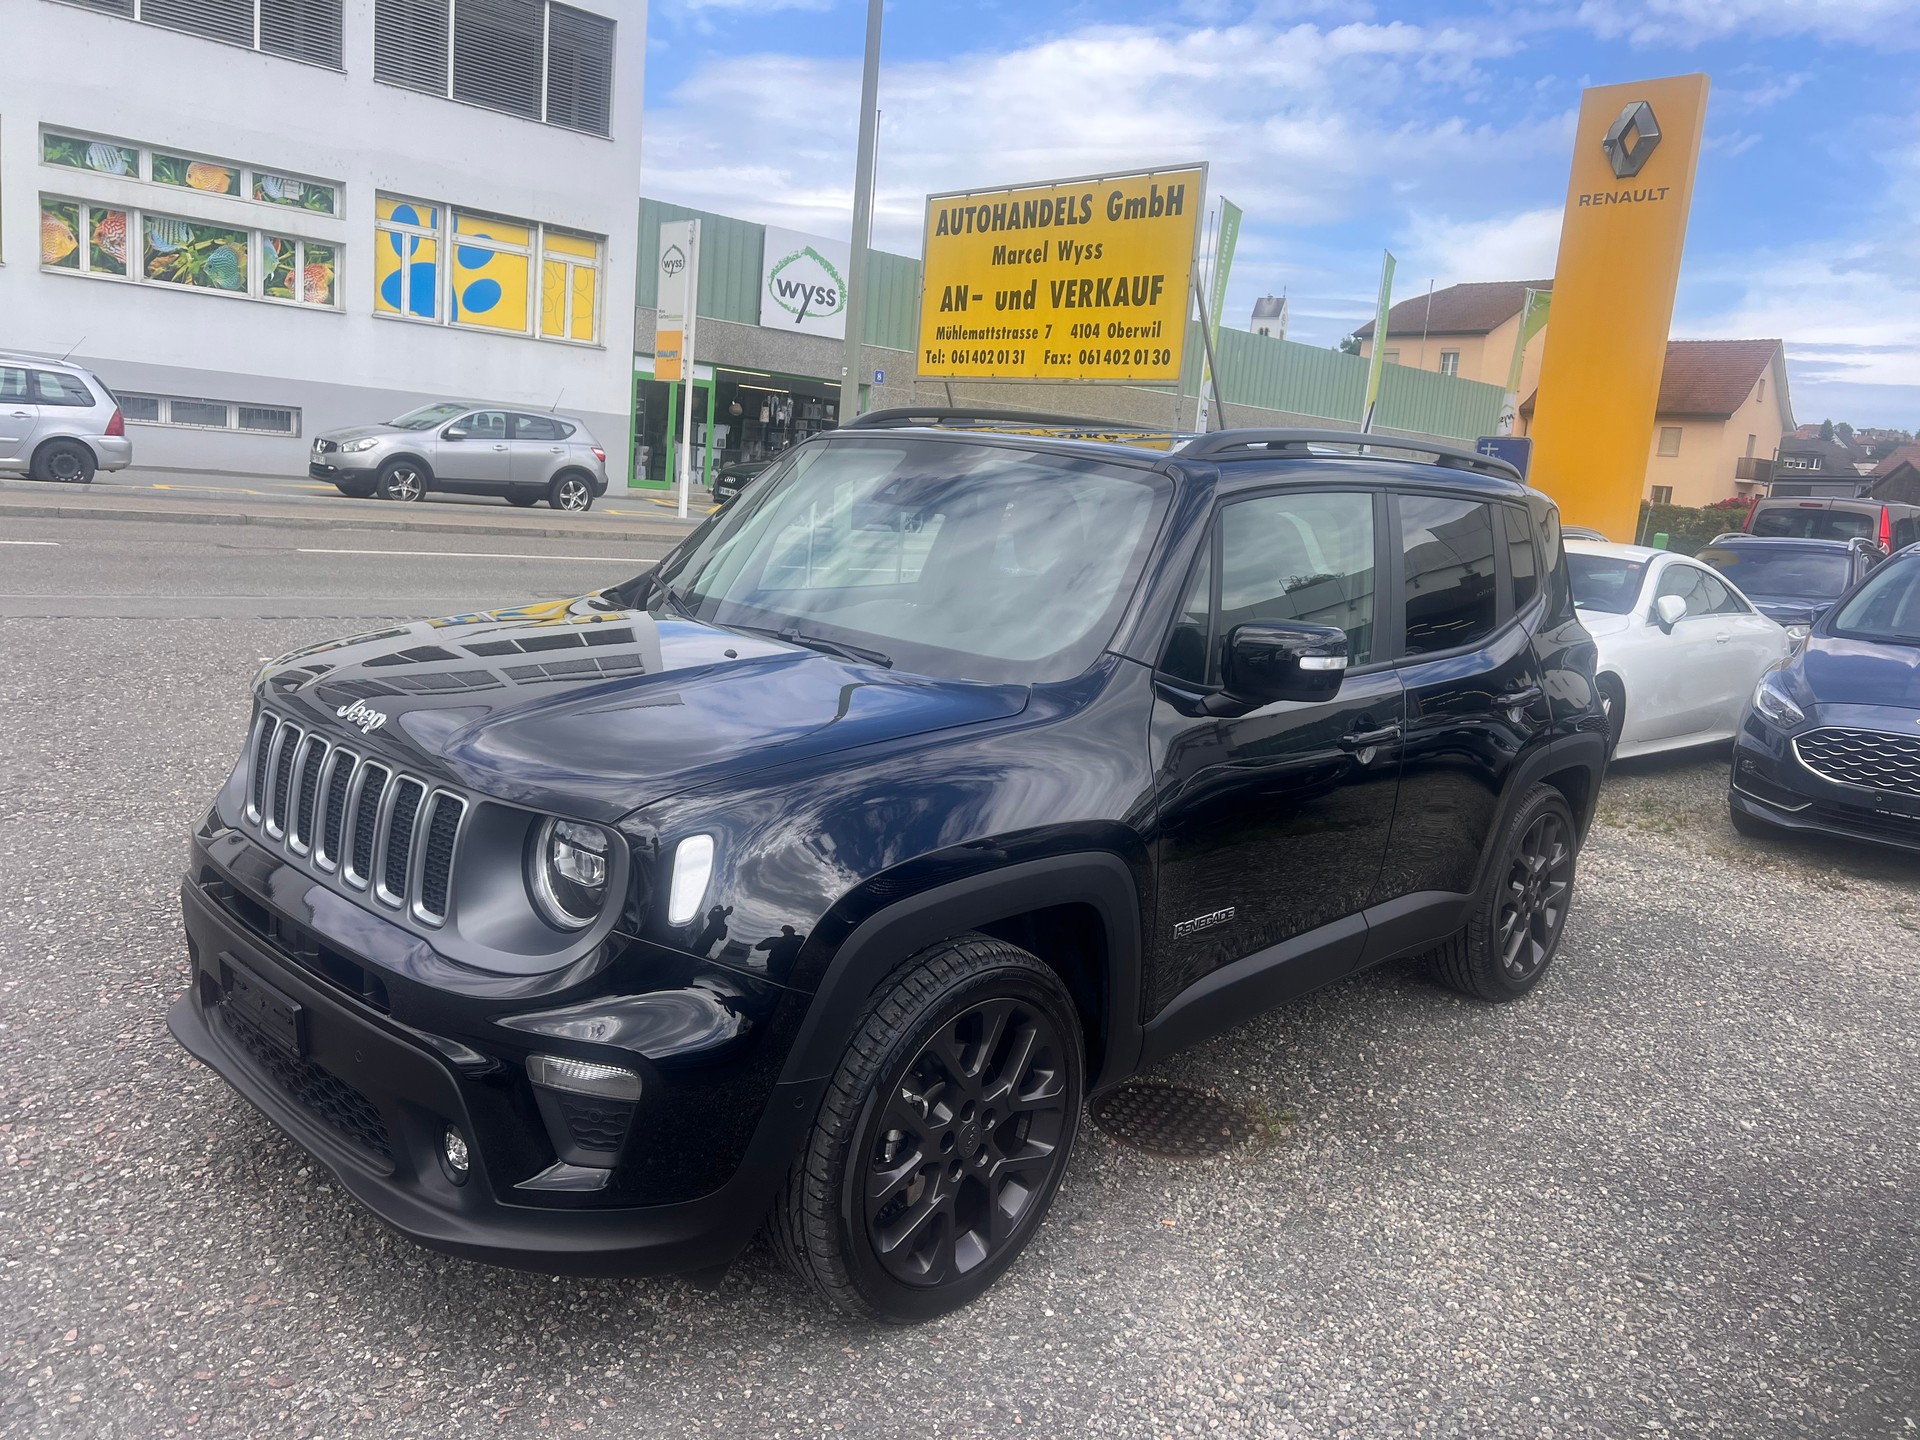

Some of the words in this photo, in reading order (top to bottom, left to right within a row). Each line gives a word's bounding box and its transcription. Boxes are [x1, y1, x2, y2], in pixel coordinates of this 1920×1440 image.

[1579, 187, 1670, 207] RENAULT
[936, 193, 1093, 236] AUTOHANDELS
[1106, 184, 1185, 222] GmbH
[992, 240, 1049, 265] Marcel
[1058, 240, 1103, 265] Wyss
[663, 259, 683, 278] wyss
[776, 278, 837, 324] wyss
[995, 279, 1037, 311] und
[1050, 275, 1164, 308] VERKAUF
[936, 325, 1039, 340] Mühlemattstrasse
[1045, 324, 1053, 339] 7
[1070, 323, 1100, 339] 4104
[1107, 320, 1162, 339] Oberwil
[926, 349, 945, 364] Tel:
[1044, 349, 1072, 365] Fax:
[876, 371, 883, 381] 8
[336, 699, 388, 735] Jeep
[1173, 906, 1235, 939] RENEGADE
